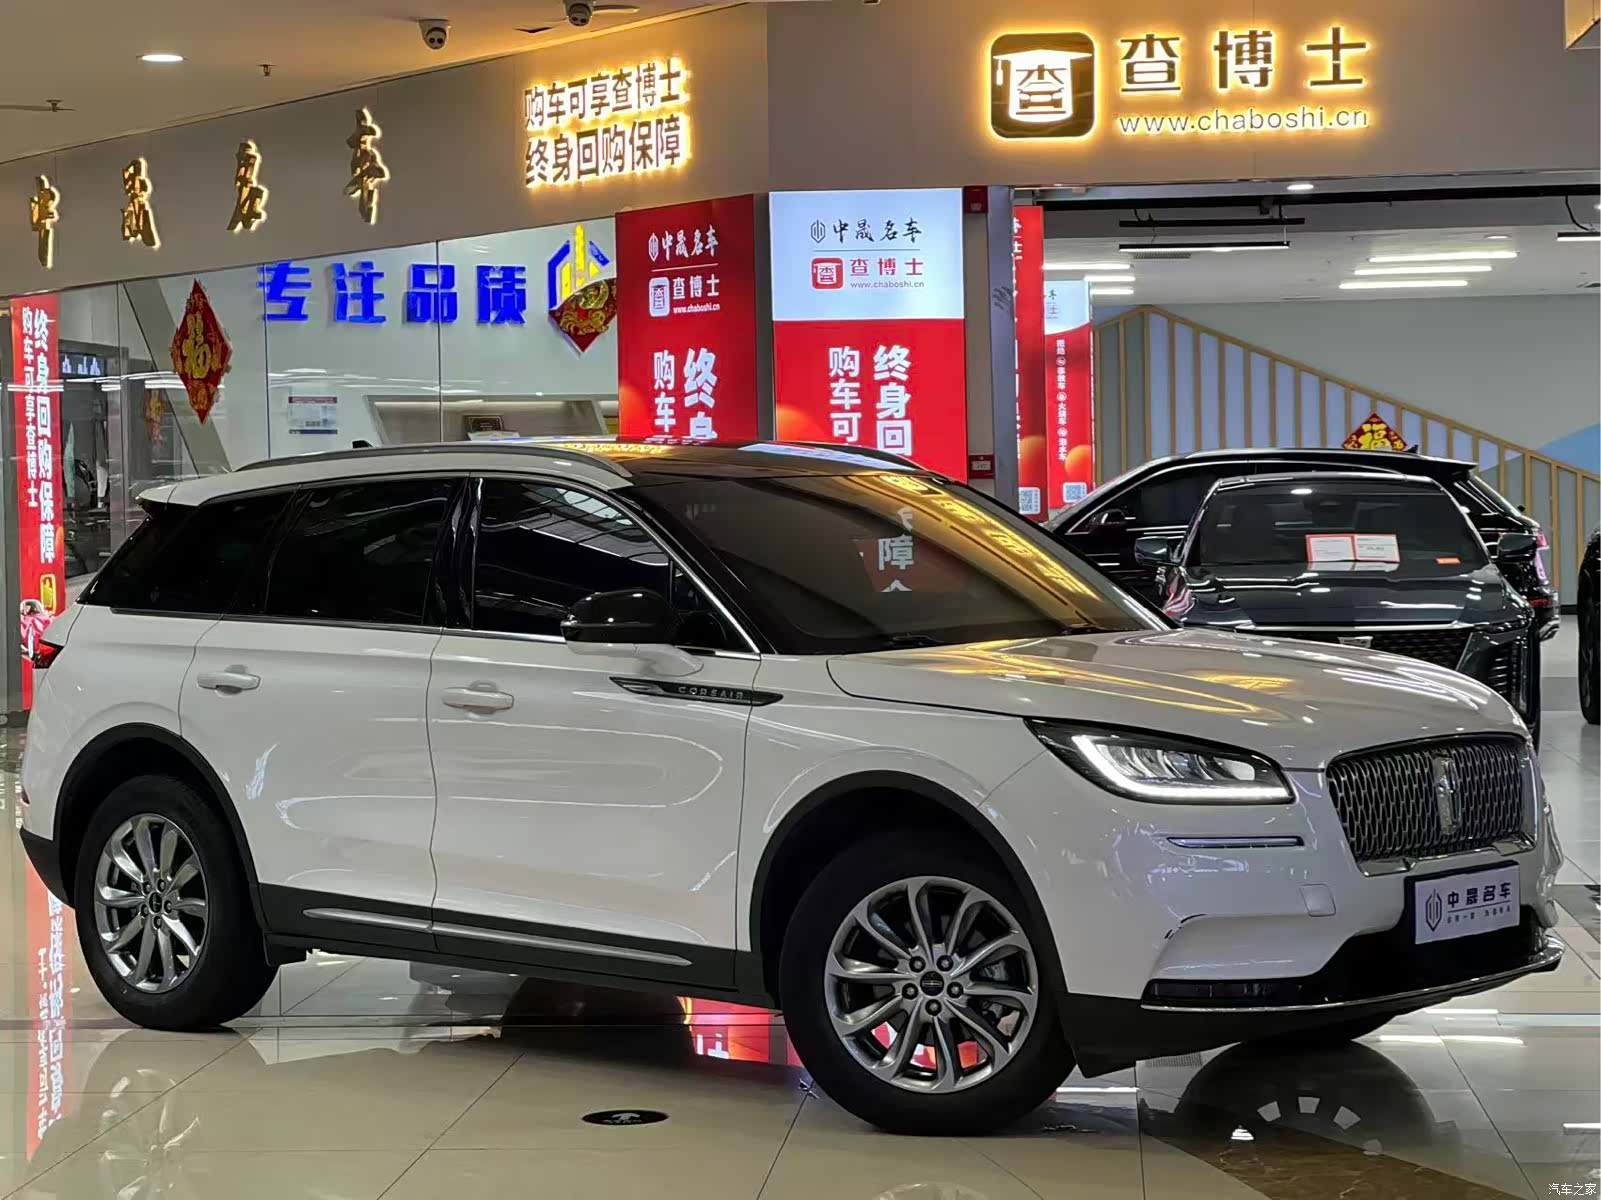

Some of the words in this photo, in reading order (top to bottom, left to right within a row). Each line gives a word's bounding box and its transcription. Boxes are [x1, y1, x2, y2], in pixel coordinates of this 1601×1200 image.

[1119, 26, 1367, 92] 查博士
[524, 58, 681, 127] 购车可享查博士
[1119, 106, 1368, 135] www.chaboshi.cn
[525, 113, 681, 185] 终身回购保障
[833, 217, 922, 244] 中晟名车
[256, 259, 526, 324] 专注品质
[672, 273, 720, 300] 查博士
[849, 257, 924, 277] 查博士
[849, 280, 925, 290] www.chaboshi.cn
[672, 302, 720, 314] www.chaboshi.cn
[21, 306, 38, 508] 购车可享查博士
[653, 349, 676, 432] 购车
[872, 344, 912, 457] 终身回
[34, 307, 57, 563] 终身回购保障
[678, 686, 744, 700] CORSAIR
